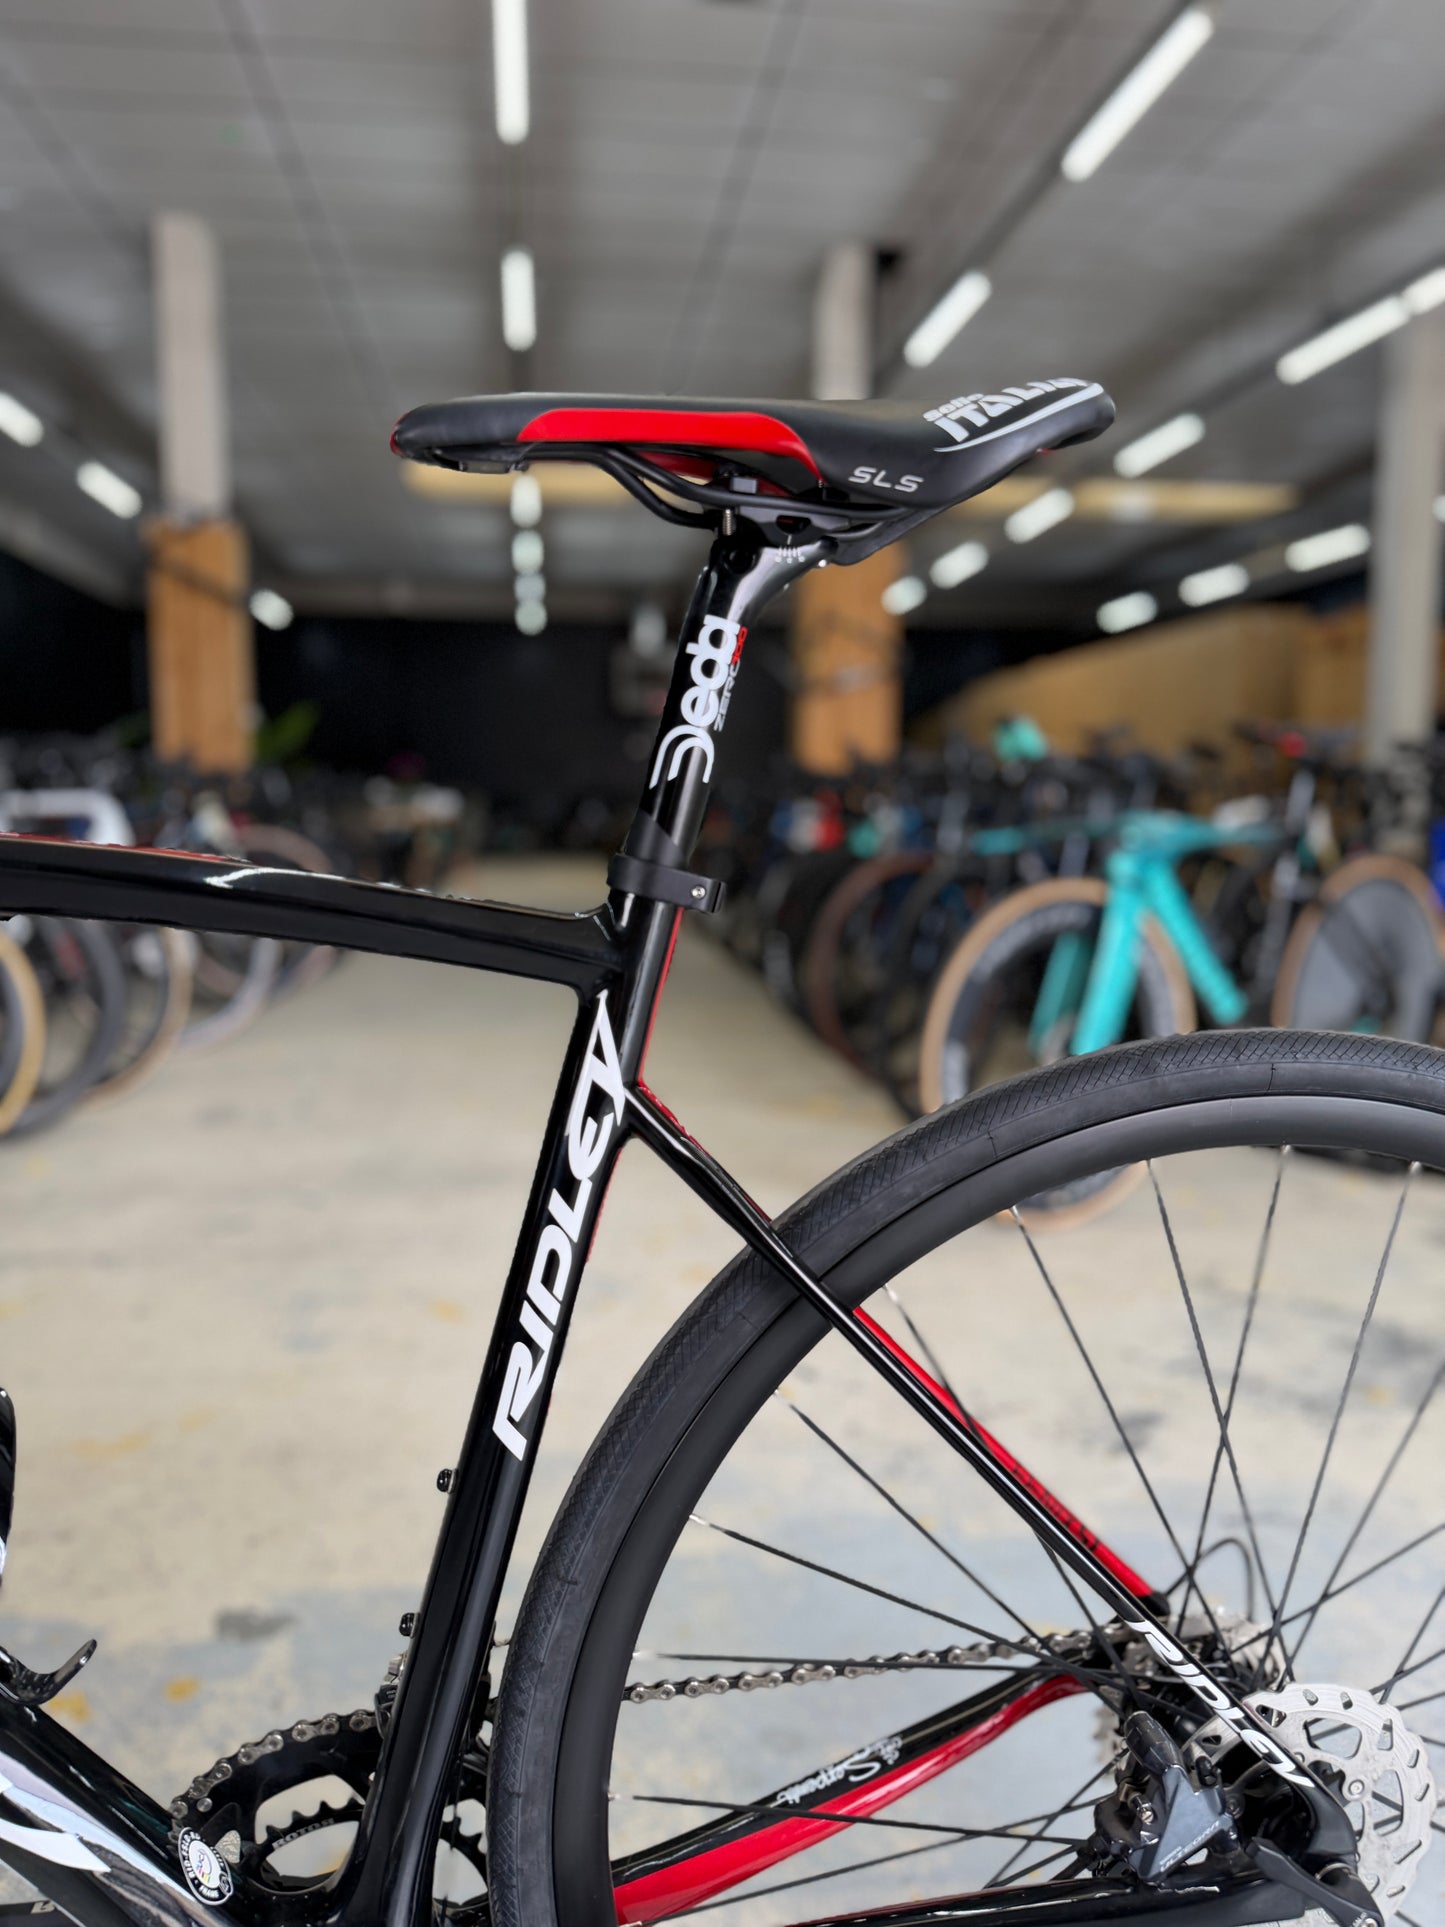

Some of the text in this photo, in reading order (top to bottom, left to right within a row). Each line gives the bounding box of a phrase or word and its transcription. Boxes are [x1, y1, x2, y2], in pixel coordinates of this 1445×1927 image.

[848, 465, 925, 493] SLS
[934, 377, 1089, 443] ITALIA
[649, 614, 741, 790] Deda
[492, 989, 626, 1461] RIDLEY
[1124, 1619, 1316, 1788] RIDLEY
